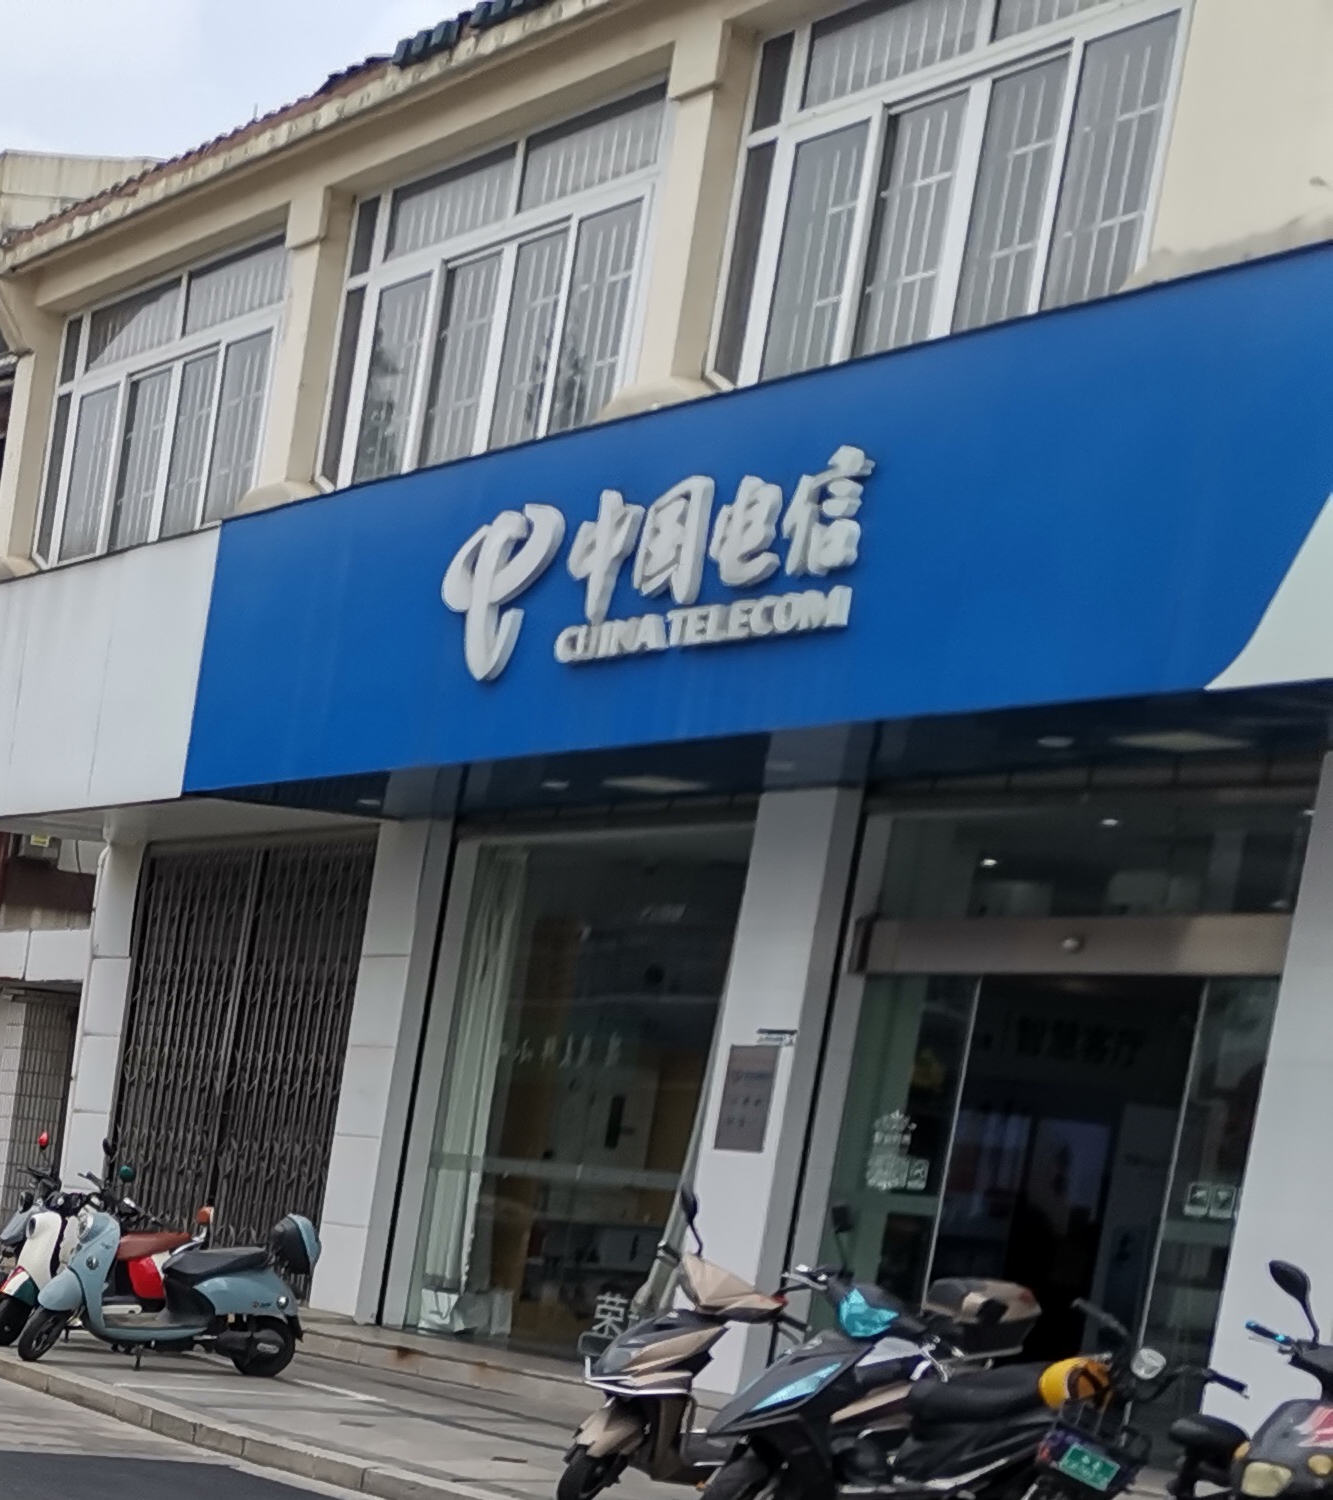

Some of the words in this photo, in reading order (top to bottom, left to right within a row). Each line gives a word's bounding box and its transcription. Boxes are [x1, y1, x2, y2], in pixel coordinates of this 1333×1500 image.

[567, 445, 876, 625] 中国电信
[553, 613, 668, 664] CHINA
[666, 585, 854, 648] TELECOM
